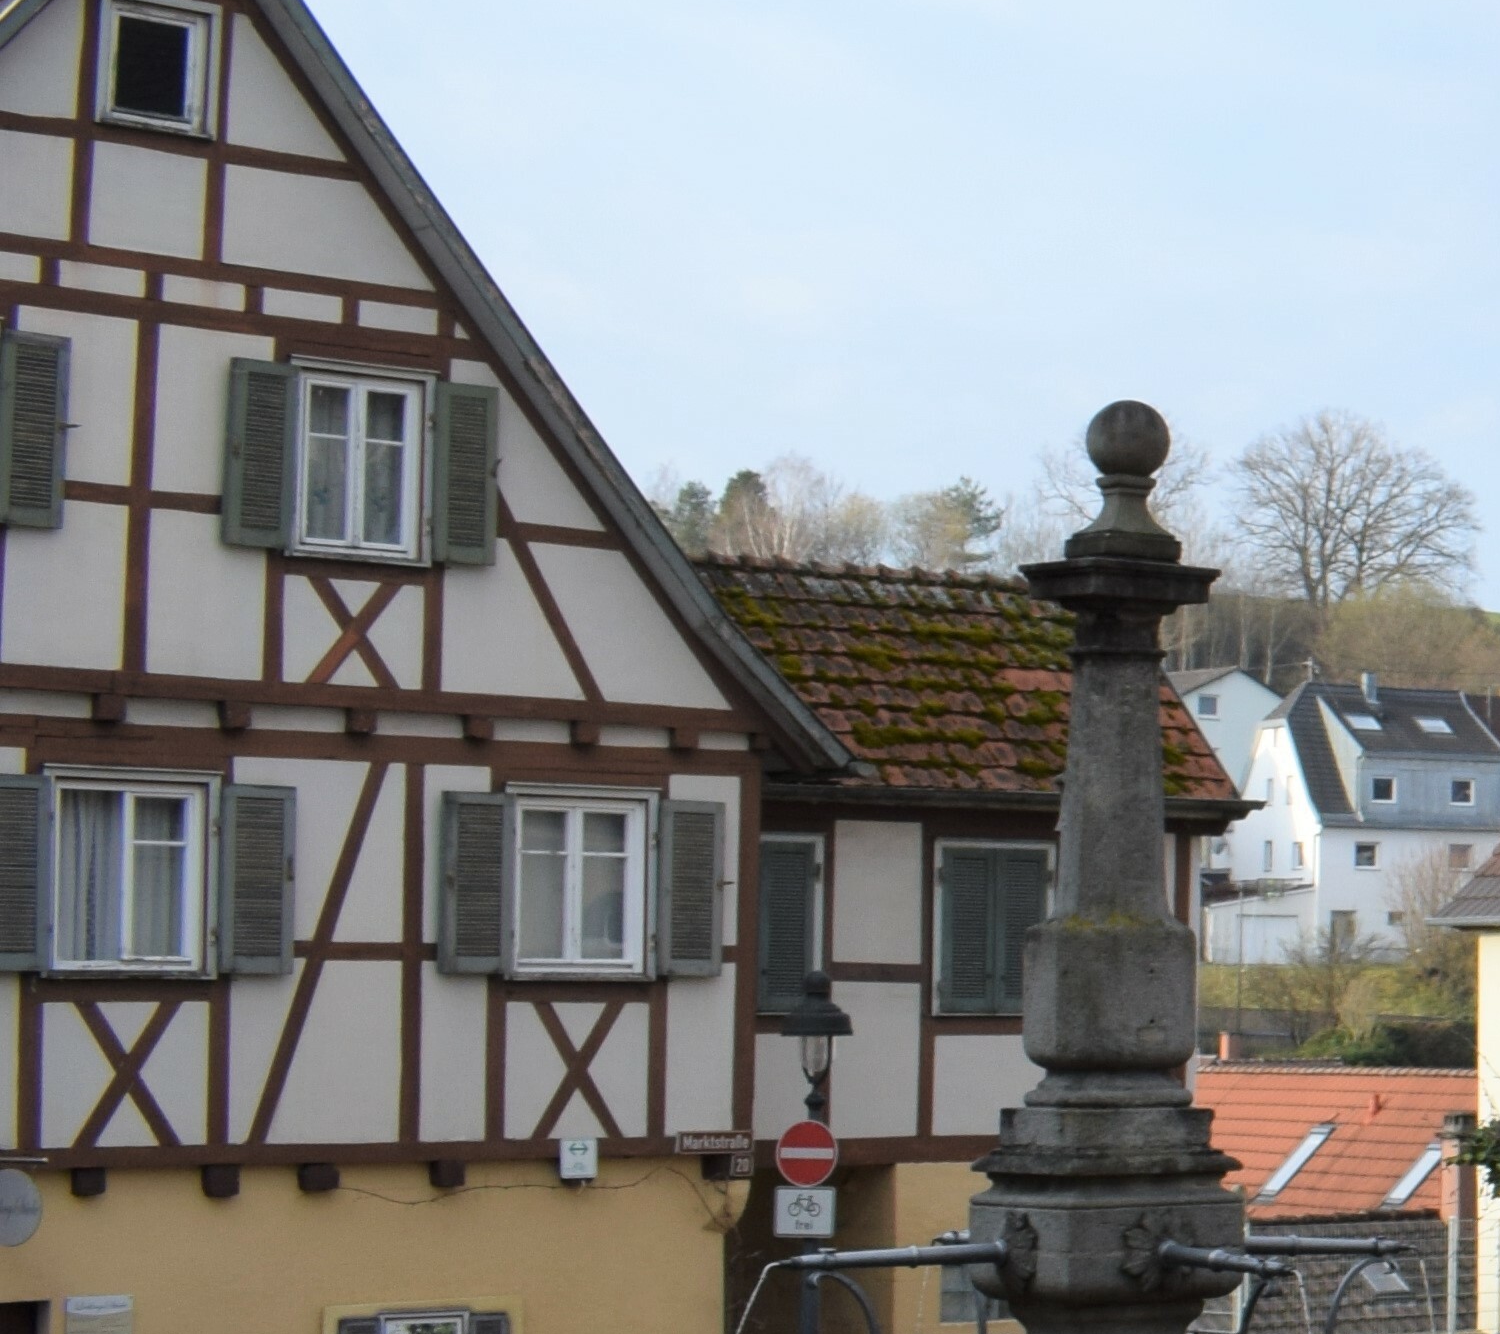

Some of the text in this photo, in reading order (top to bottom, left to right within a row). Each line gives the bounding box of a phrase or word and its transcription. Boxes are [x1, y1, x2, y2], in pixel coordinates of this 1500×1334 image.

[682, 1134, 750, 1150] Marktstraße
[736, 1158, 750, 1173] 20
[795, 1219, 813, 1230] frei
